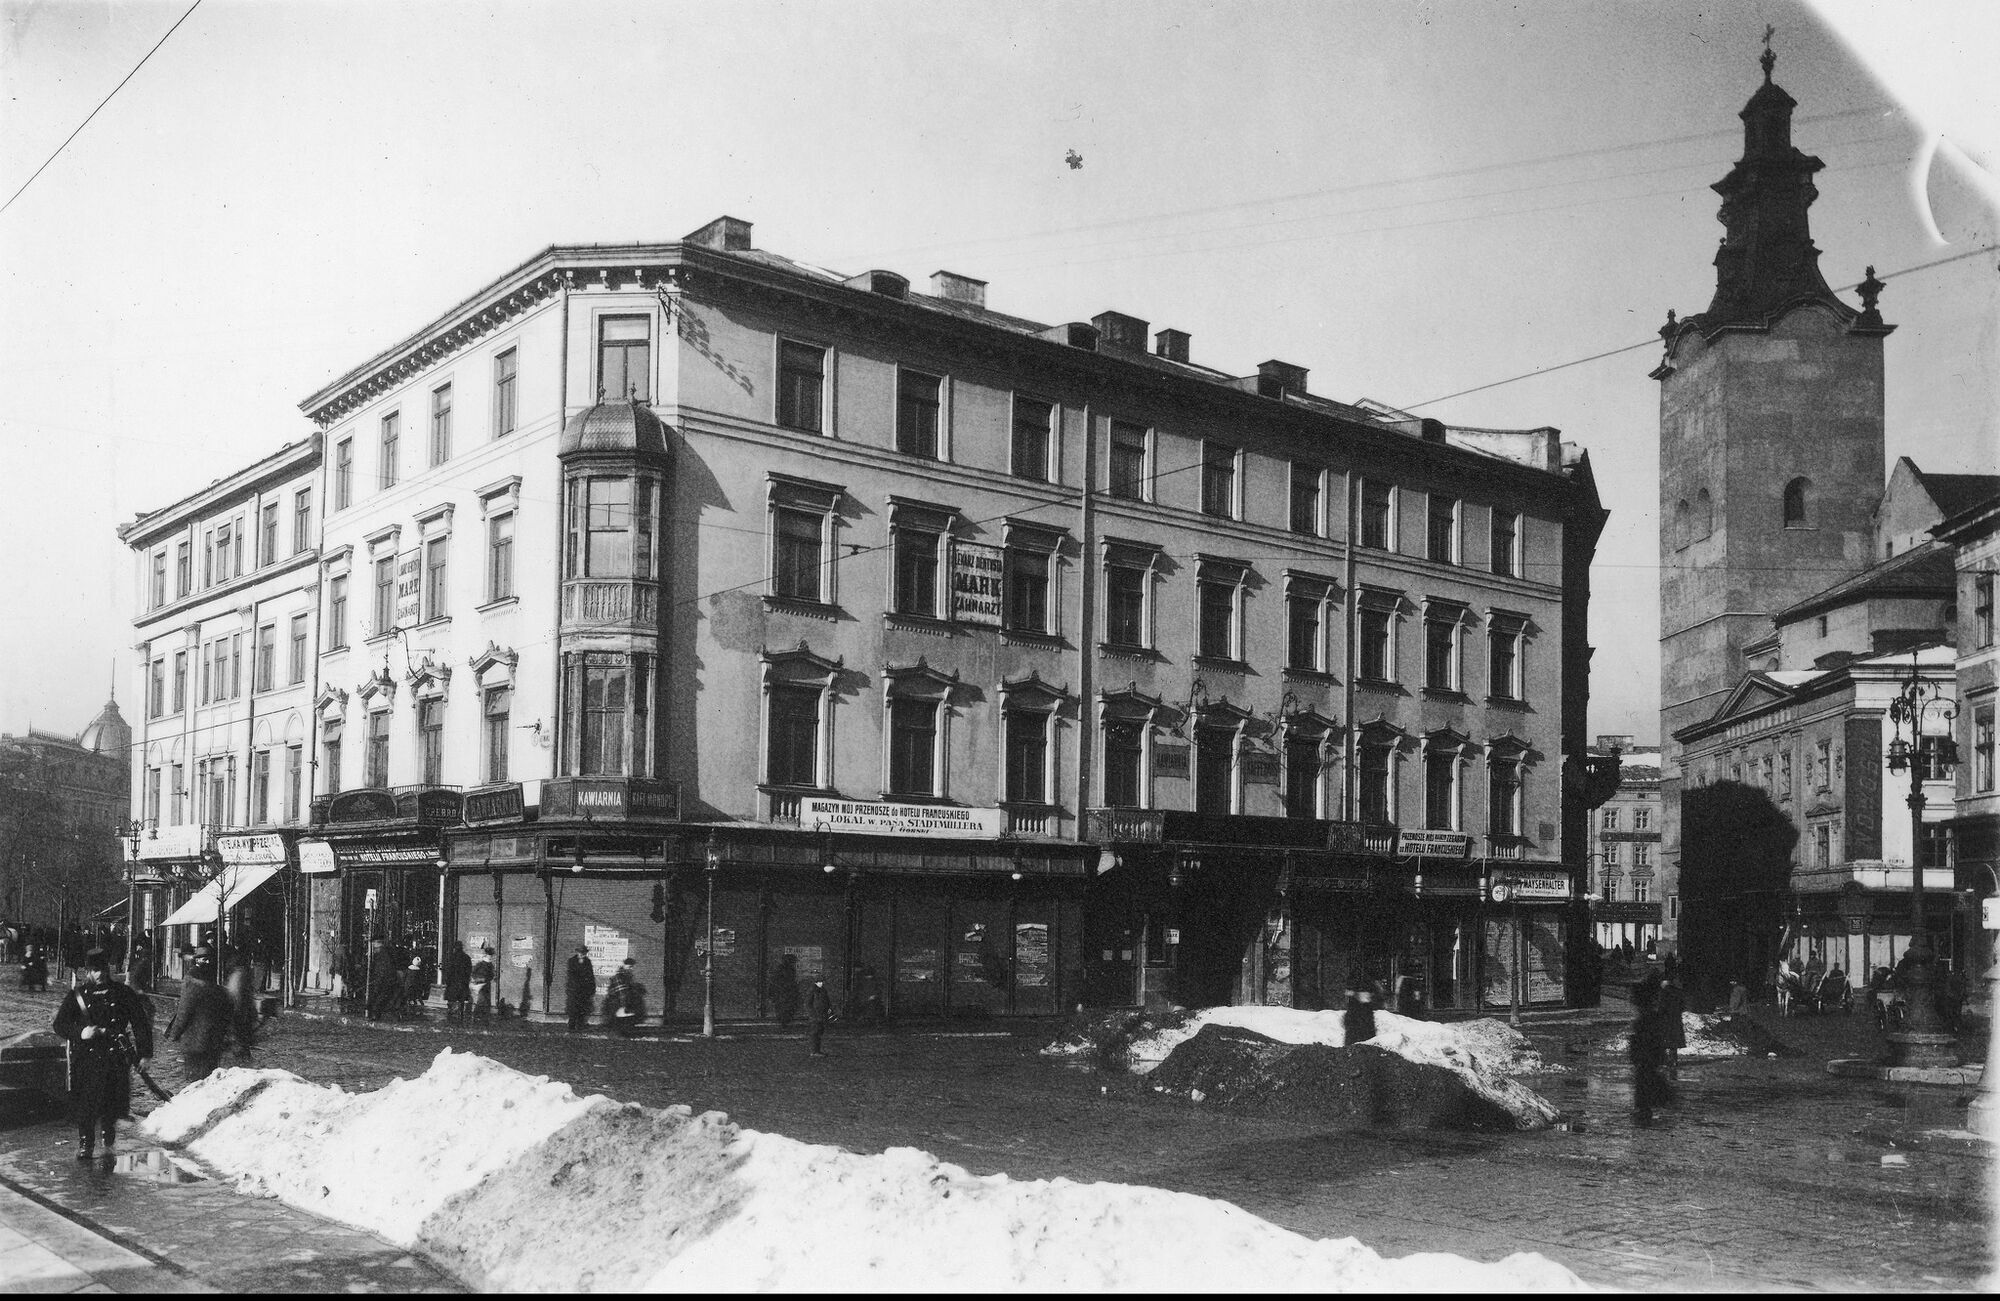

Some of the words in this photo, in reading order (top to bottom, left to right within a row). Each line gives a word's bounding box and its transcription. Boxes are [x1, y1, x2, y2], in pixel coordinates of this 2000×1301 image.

[398, 577, 418, 599] MARK
[954, 572, 1001, 597] MARK
[955, 596, 1001, 615] ZAHNARZT
[578, 791, 622, 806] KAWIARNIA
[811, 802, 839, 813] MAGAZYN
[900, 807, 920, 818] HOTELU
[922, 808, 970, 820] FRANCUSKIEGO
[830, 814, 865, 825] LOKAL
[1405, 842, 1426, 854] HOTELU
